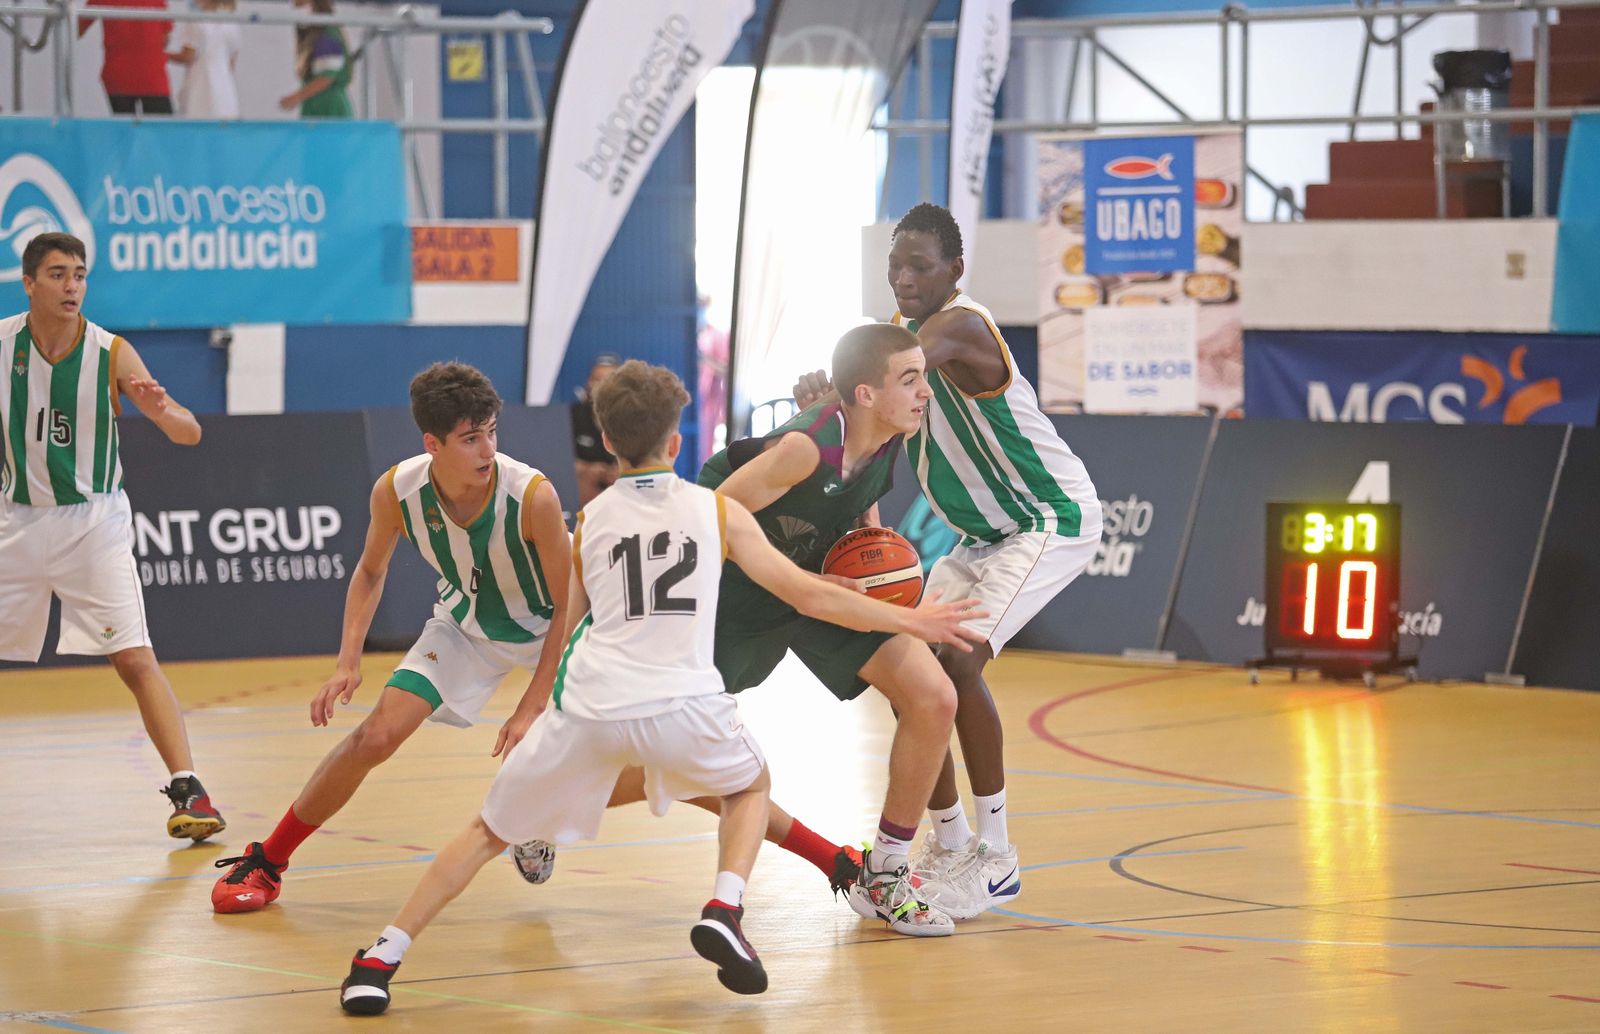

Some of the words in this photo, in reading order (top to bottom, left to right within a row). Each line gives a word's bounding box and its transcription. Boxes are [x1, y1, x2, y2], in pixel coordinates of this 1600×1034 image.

[103, 174, 326, 225] baloncesto
[1096, 197, 1182, 241] UBAGO
[1087, 361, 1116, 382] DE
[1121, 360, 1193, 381] SABOR
[36, 407, 72, 448] 15
[129, 509, 200, 557] NT
[208, 504, 343, 554] GRUP
[837, 529, 898, 551] molten
[1303, 512, 1377, 554] 3:17
[216, 557, 244, 584] DE
[250, 553, 346, 583] SEGUROS
[608, 530, 698, 621] 12
[860, 548, 884, 562] FIBA
